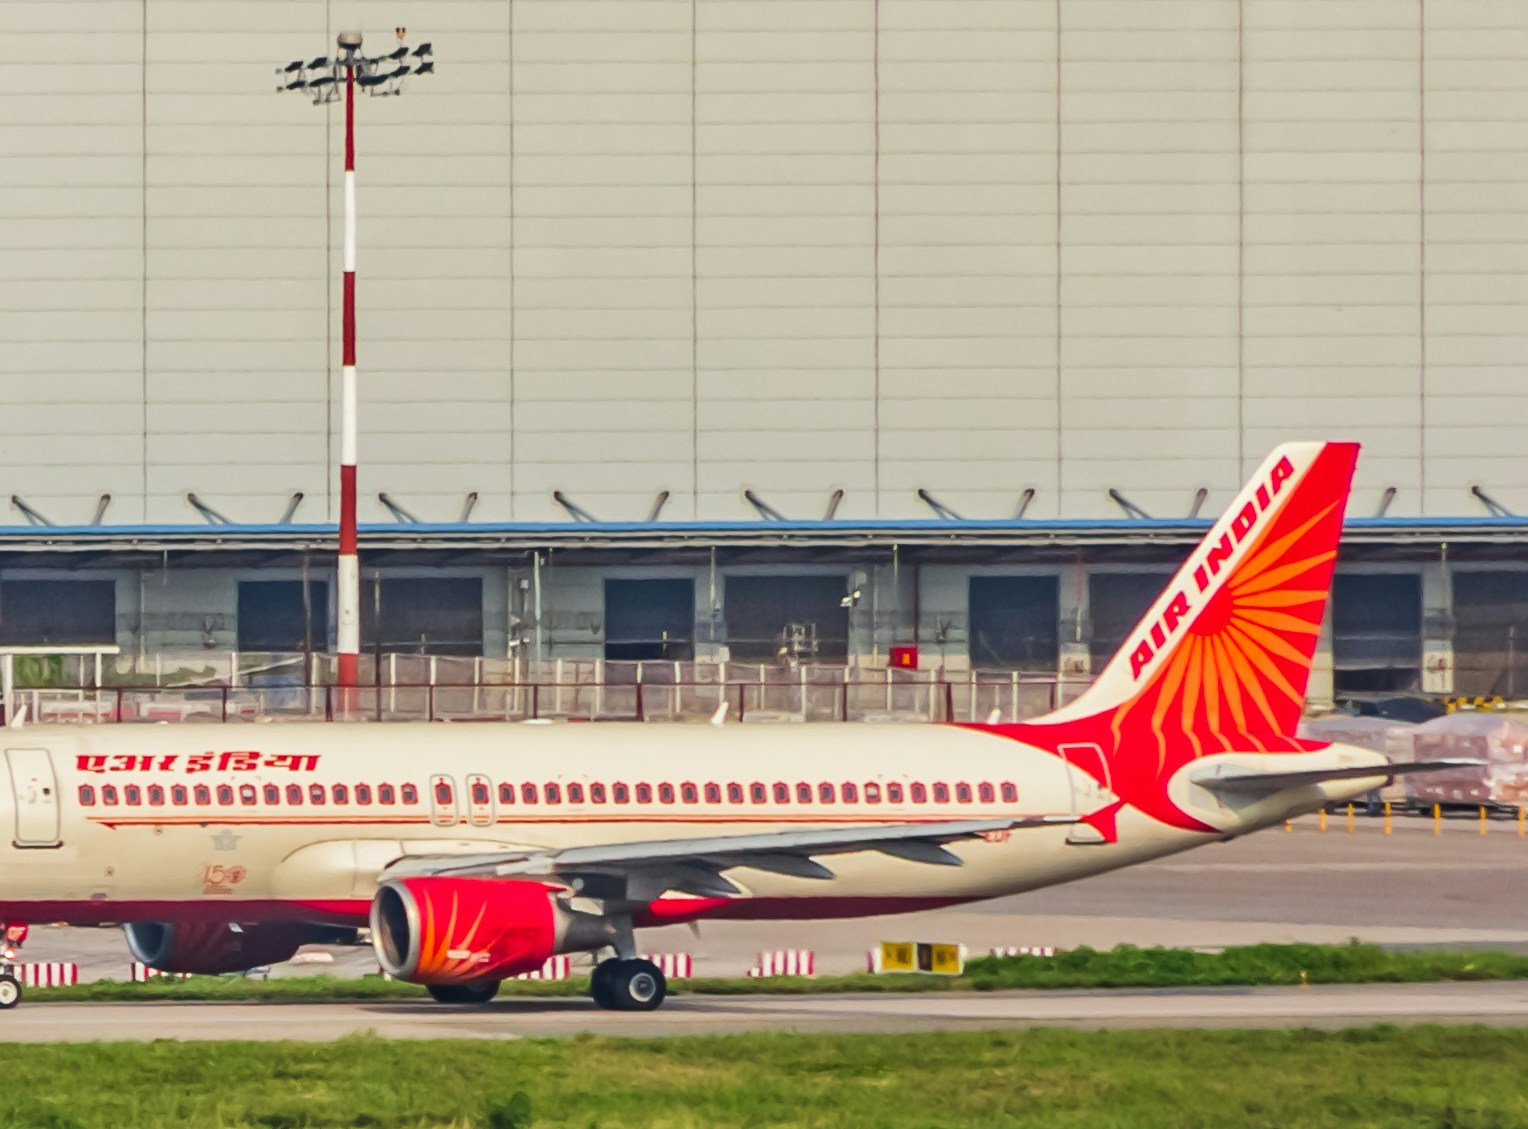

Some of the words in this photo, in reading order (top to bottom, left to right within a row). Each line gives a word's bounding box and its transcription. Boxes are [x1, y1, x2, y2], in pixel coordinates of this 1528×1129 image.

[1129, 590, 1192, 682] AIR
[1193, 455, 1295, 594] INDIA
[186, 751, 322, 774] इंडिया
